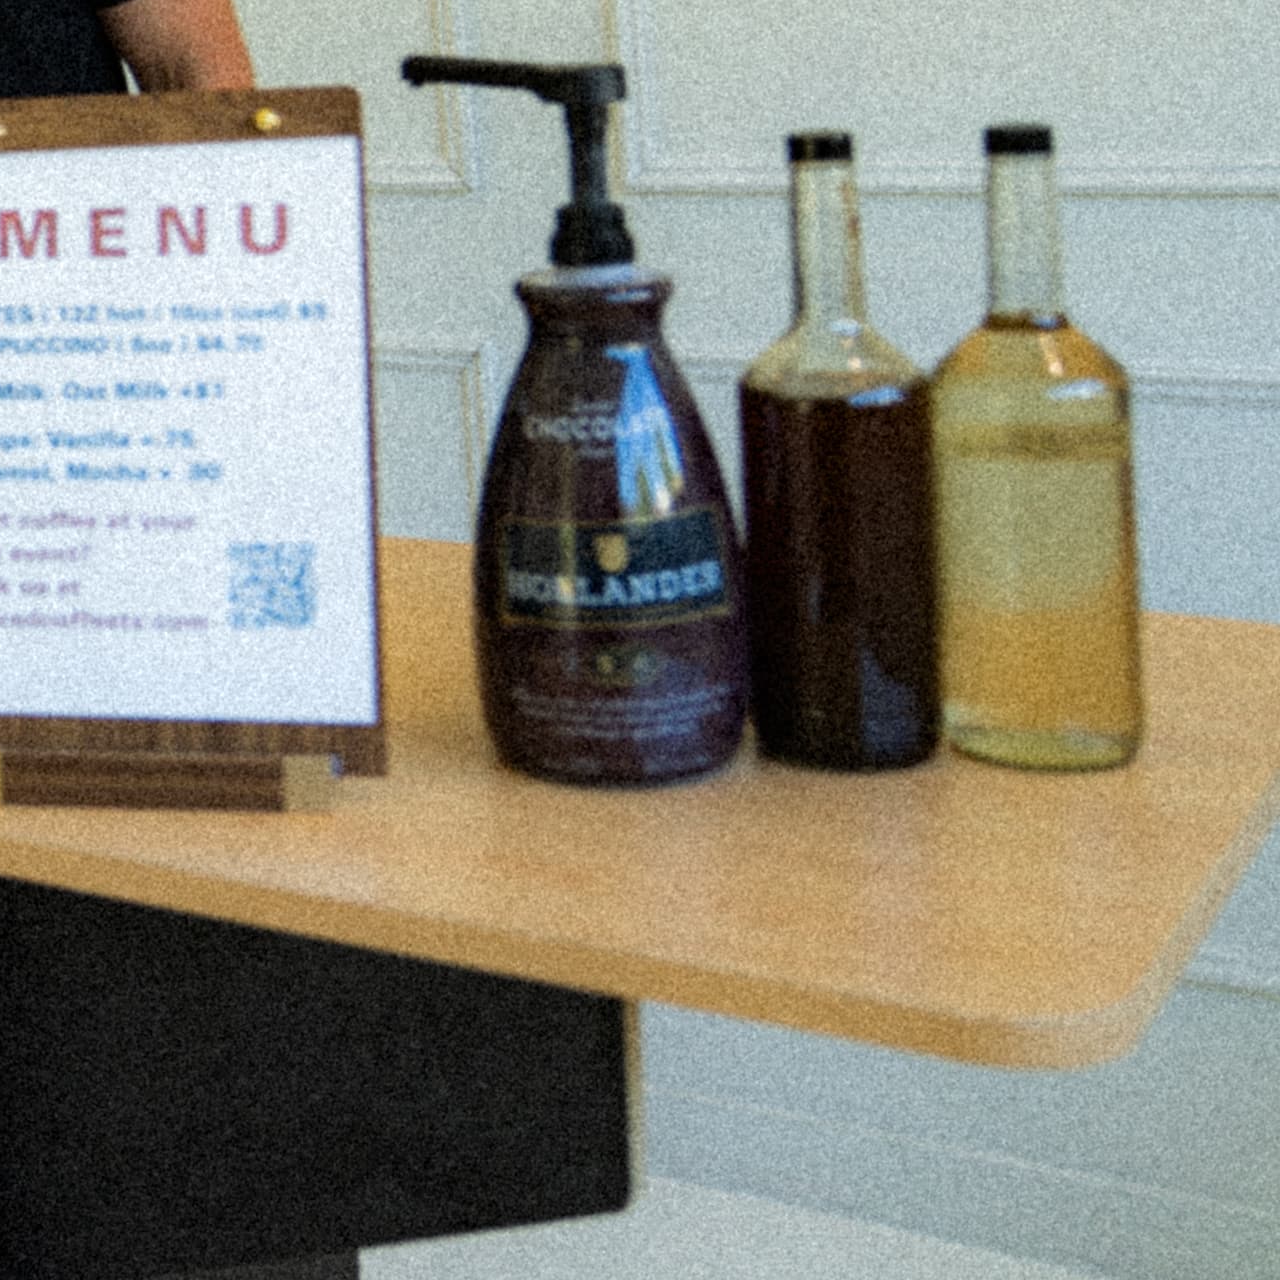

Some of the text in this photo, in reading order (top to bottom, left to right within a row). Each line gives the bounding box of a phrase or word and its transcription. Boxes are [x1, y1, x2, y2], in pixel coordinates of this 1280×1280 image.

[61, 381, 108, 401] Oat
[114, 381, 169, 402] Milk
[46, 429, 131, 450] Vanilla
[66, 461, 149, 482] Mocha
[18, 509, 97, 530] coffee
[106, 511, 130, 529] at
[139, 513, 196, 534] your
[19, 580, 48, 596] us
[57, 579, 81, 596] at
[507, 561, 723, 606] HOLLANDER
